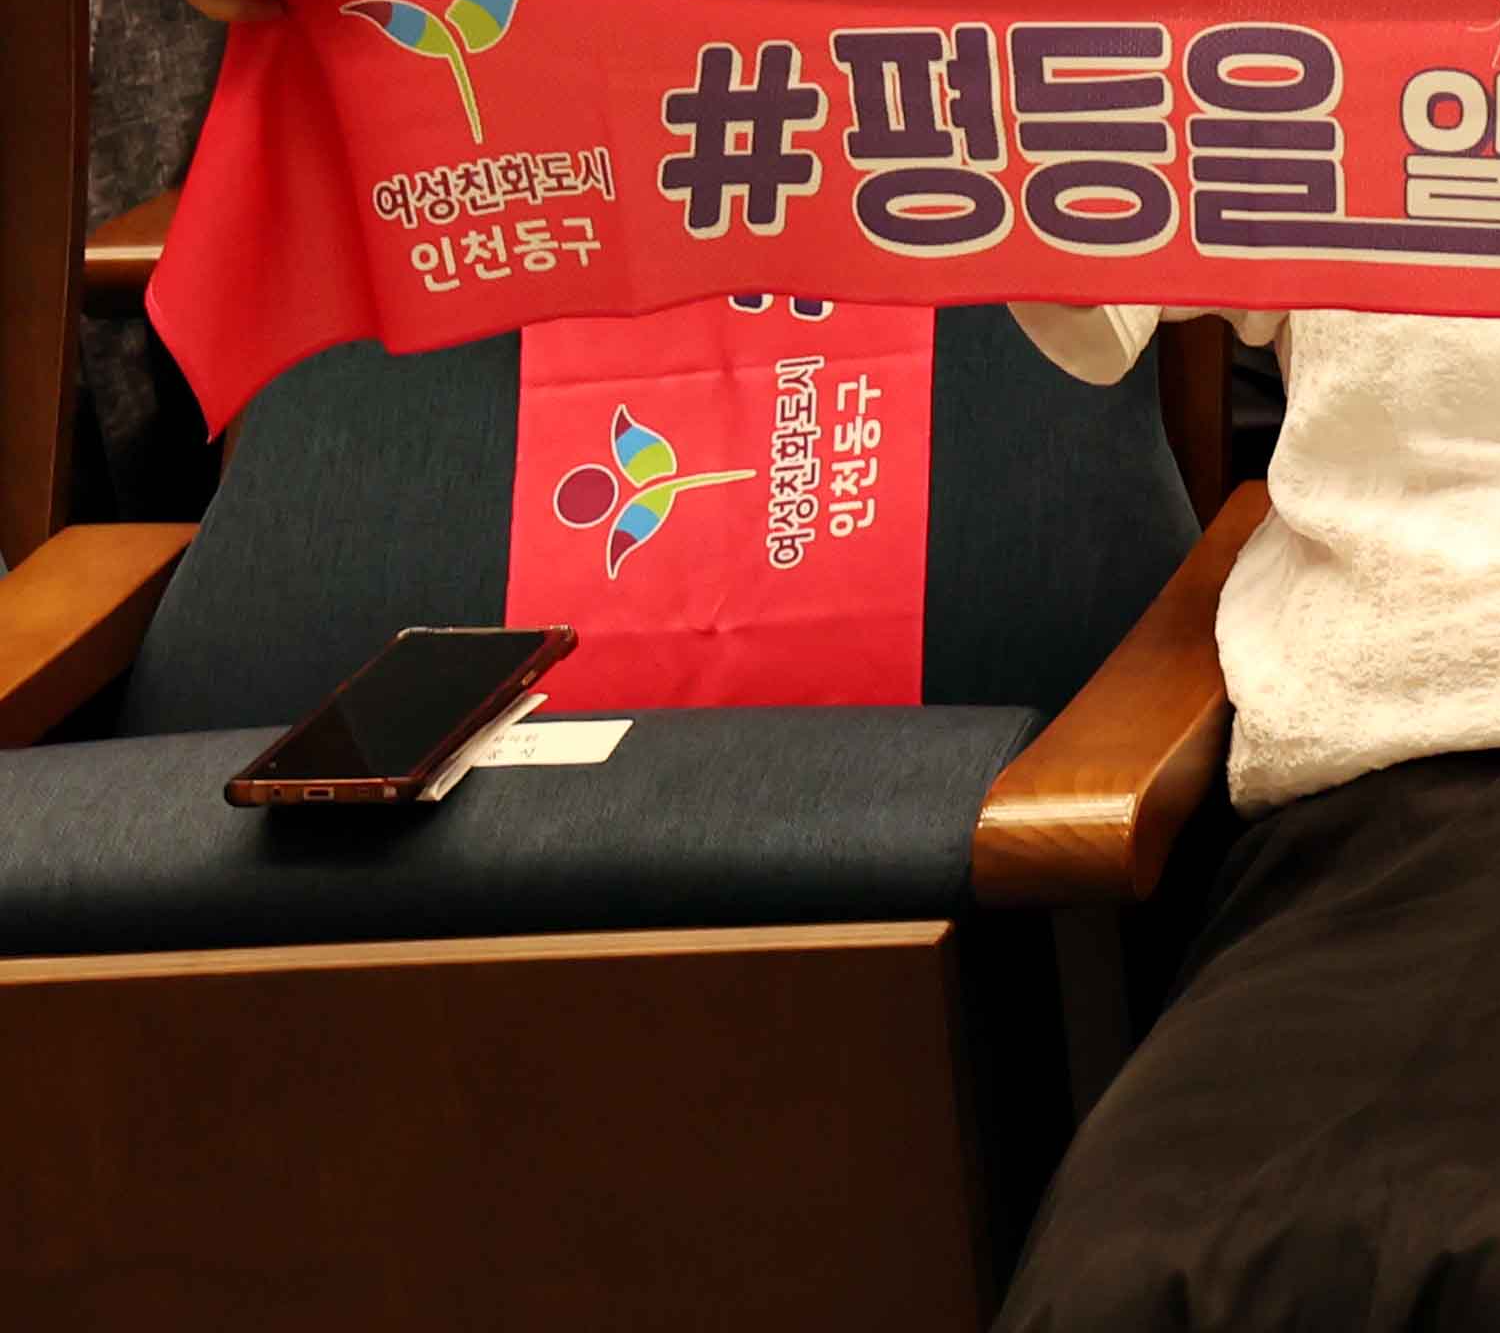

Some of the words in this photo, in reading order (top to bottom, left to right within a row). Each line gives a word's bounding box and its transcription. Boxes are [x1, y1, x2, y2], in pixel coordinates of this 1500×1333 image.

[372, 145, 616, 227] 여성친화도시
[659, 20, 1345, 260] #평등을
[410, 218, 603, 293] 인천동구
[767, 353, 828, 570] 여성친화도시
[830, 373, 884, 539] 인천동구
